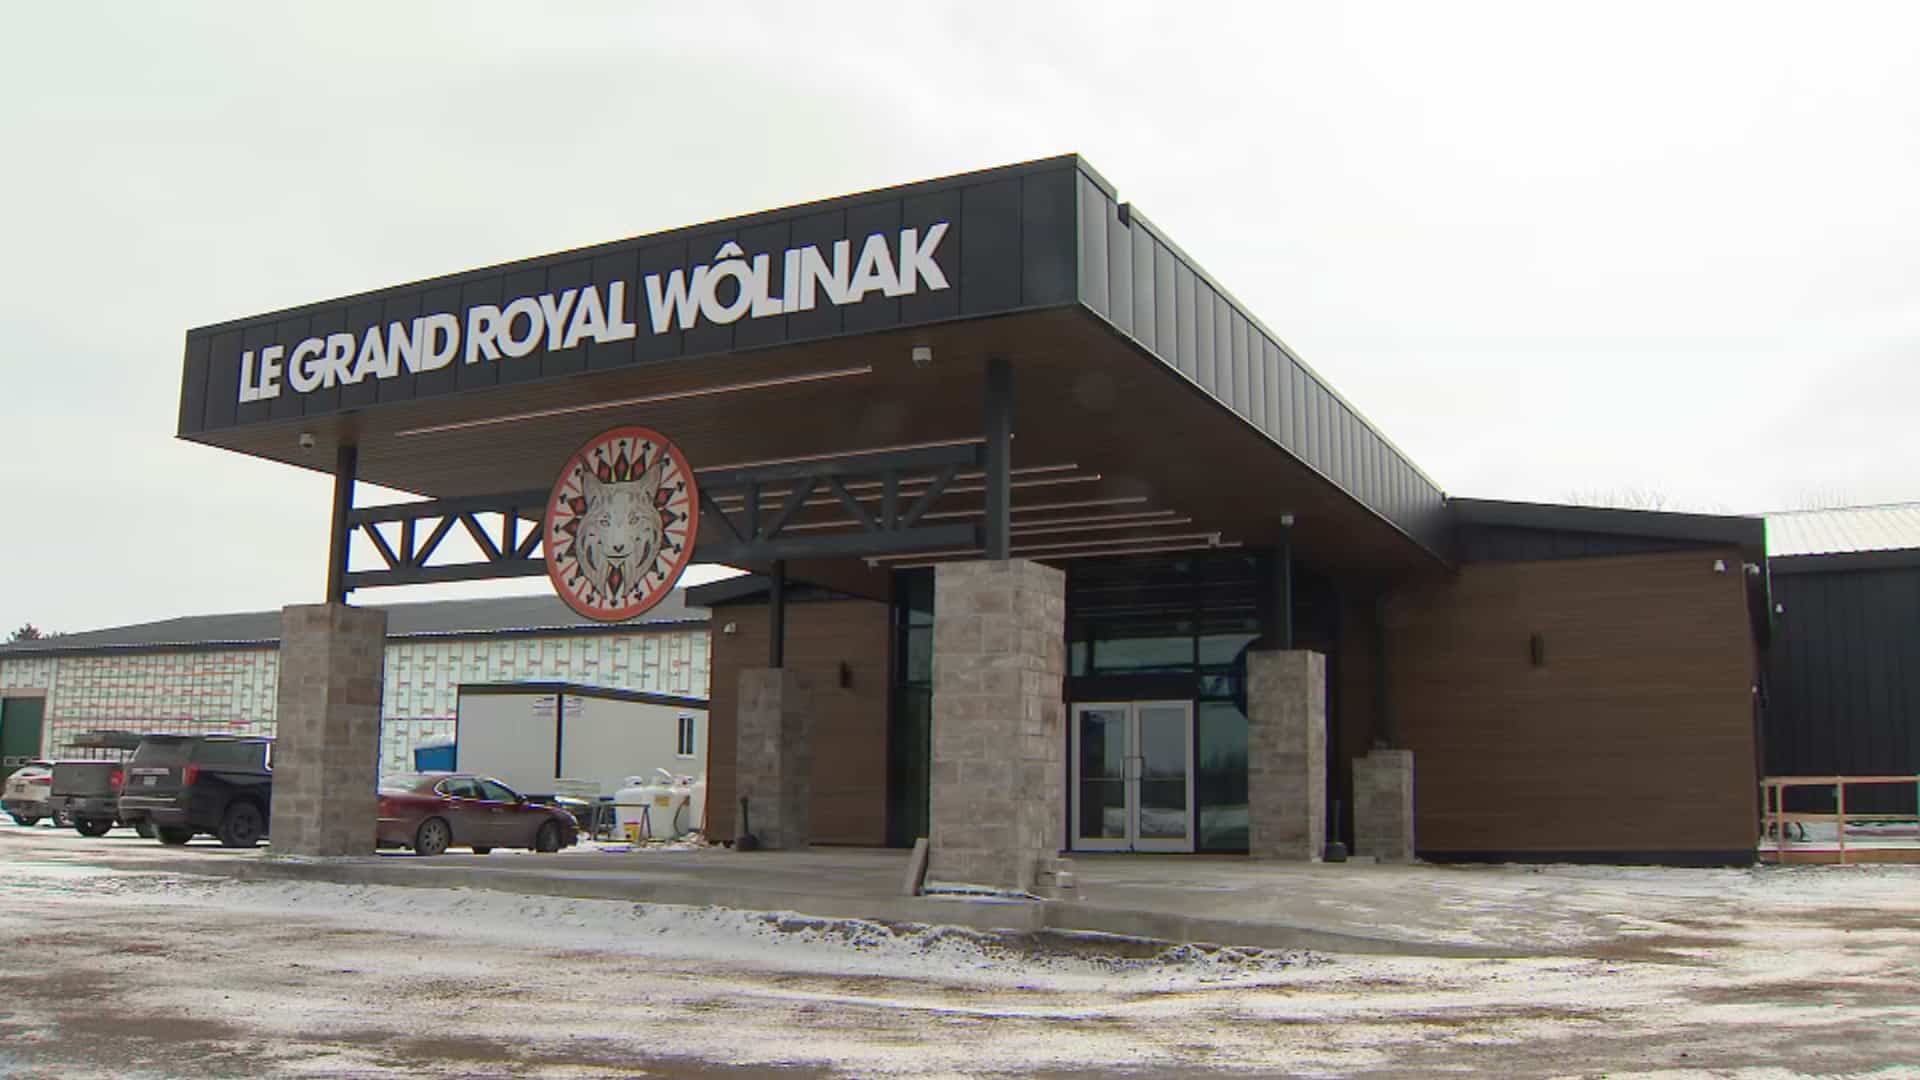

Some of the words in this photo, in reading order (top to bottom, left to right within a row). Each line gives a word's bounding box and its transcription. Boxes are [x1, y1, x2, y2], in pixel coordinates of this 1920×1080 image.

[238, 345, 284, 403] LE
[287, 313, 460, 393] GRAND
[464, 280, 637, 364] ROYAL
[644, 222, 950, 334] WÔLINAK
